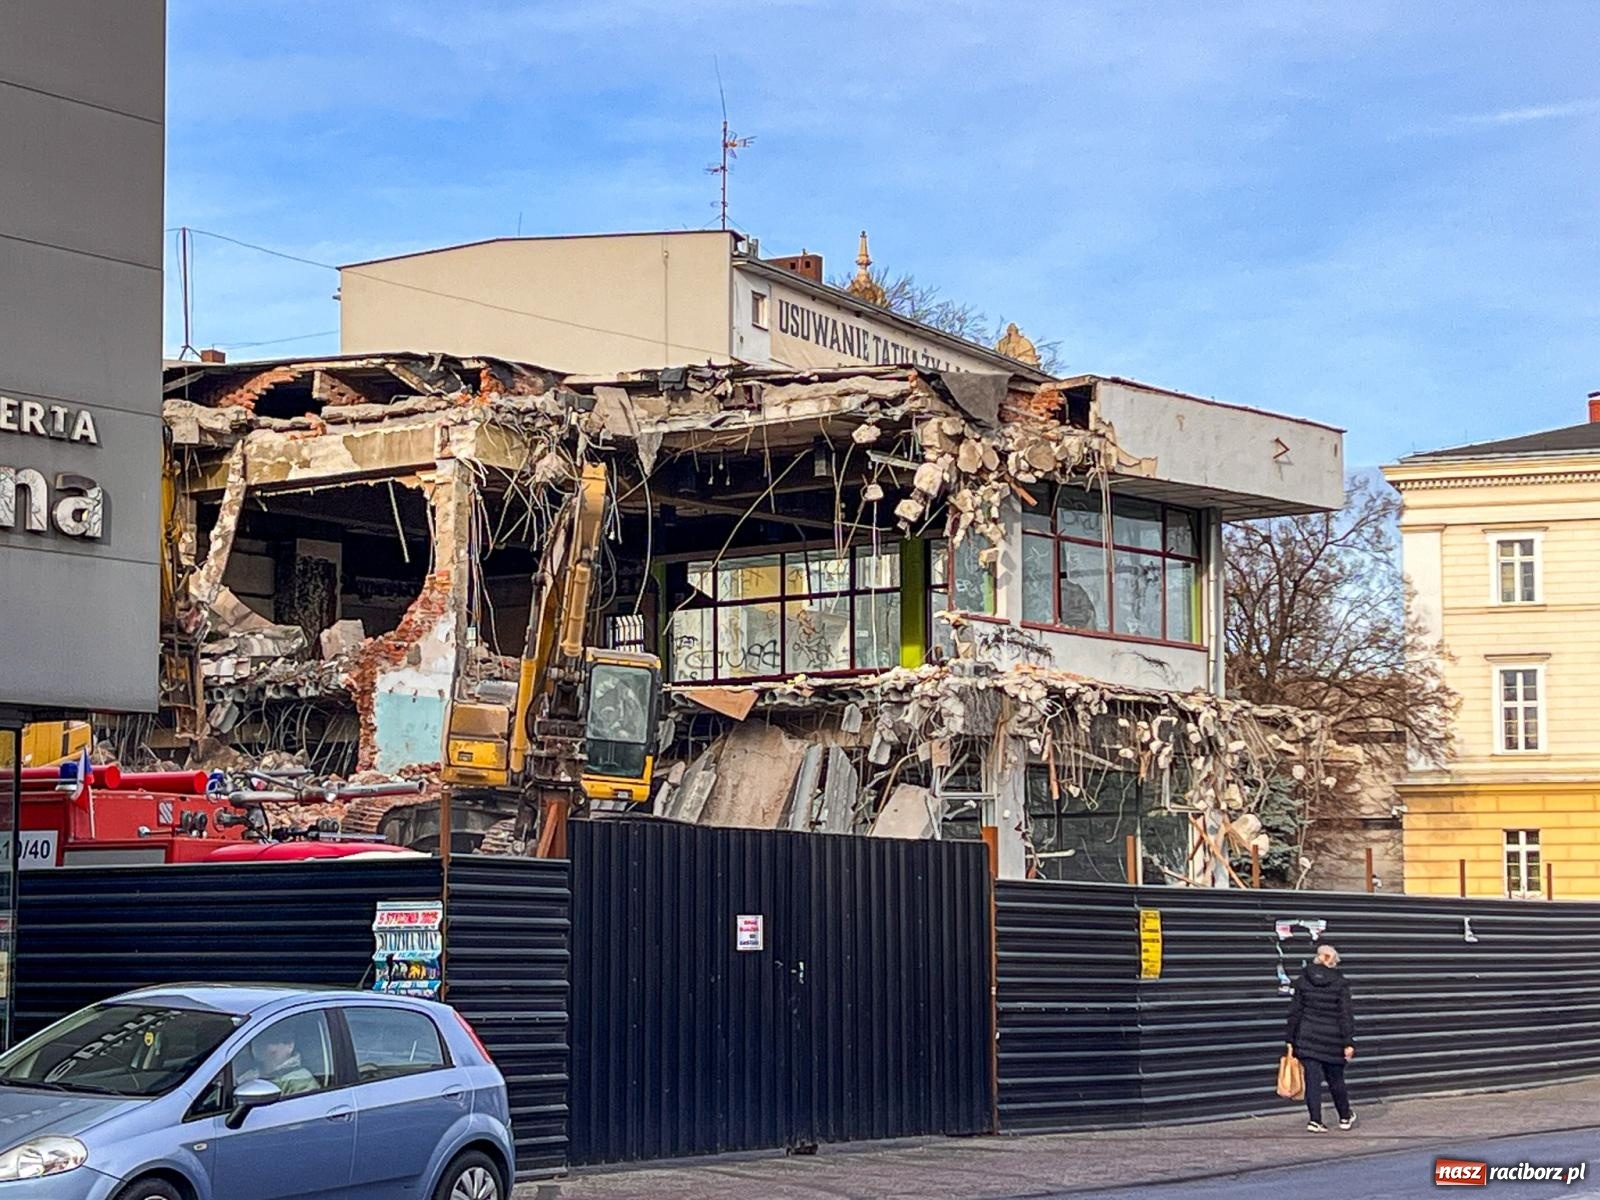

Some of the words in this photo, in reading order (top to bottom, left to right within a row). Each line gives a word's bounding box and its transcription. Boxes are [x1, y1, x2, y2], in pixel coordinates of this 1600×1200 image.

[778, 298, 870, 362] USUWANIE
[0, 396, 98, 445] ERTA
[0, 465, 103, 538] na
